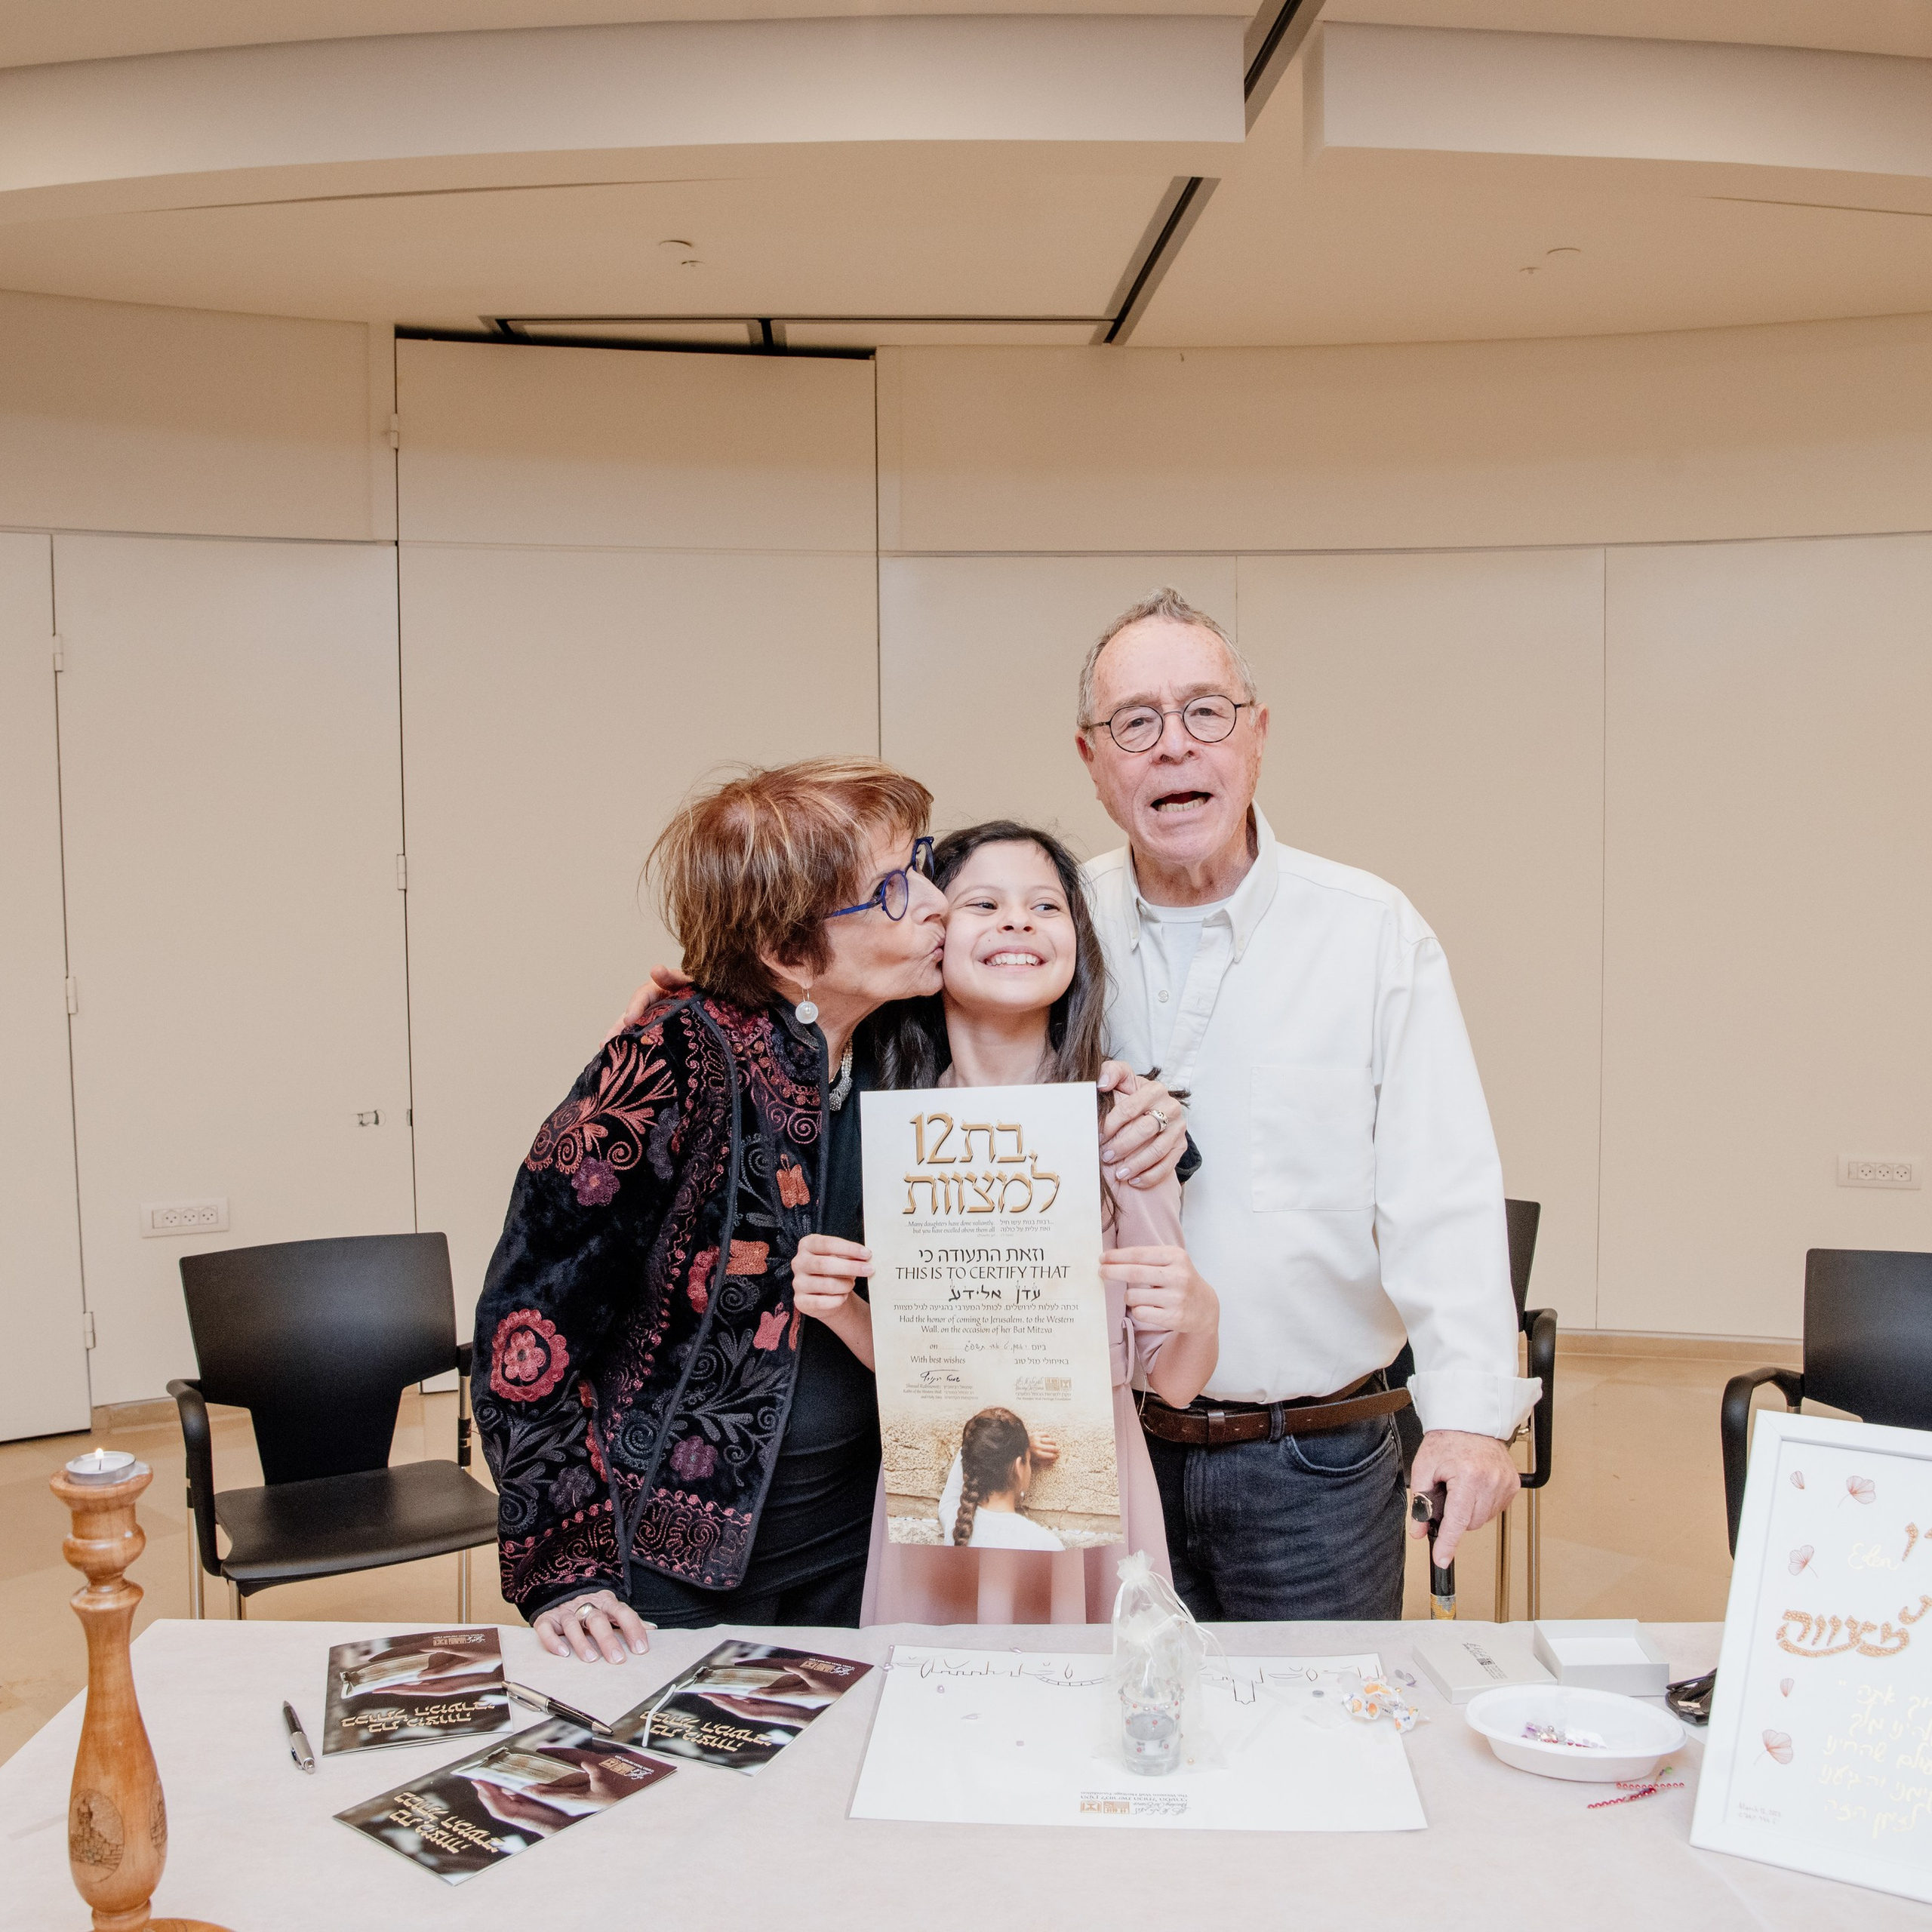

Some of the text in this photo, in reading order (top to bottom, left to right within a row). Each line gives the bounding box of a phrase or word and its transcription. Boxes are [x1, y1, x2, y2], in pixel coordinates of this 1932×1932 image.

[909, 1112, 1026, 1164] בת 12
[902, 1149, 1060, 1214] למצוות
[919, 1248, 1044, 1264] וזאת התעודה כי
[896, 1266, 1071, 1279] THIS IS TO CERTIFY THAT
[1016, 1281, 1041, 1304] עדן
[948, 1315, 956, 1324] of
[957, 1316, 981, 1326] coming
[992, 1325, 1000, 1336] of
